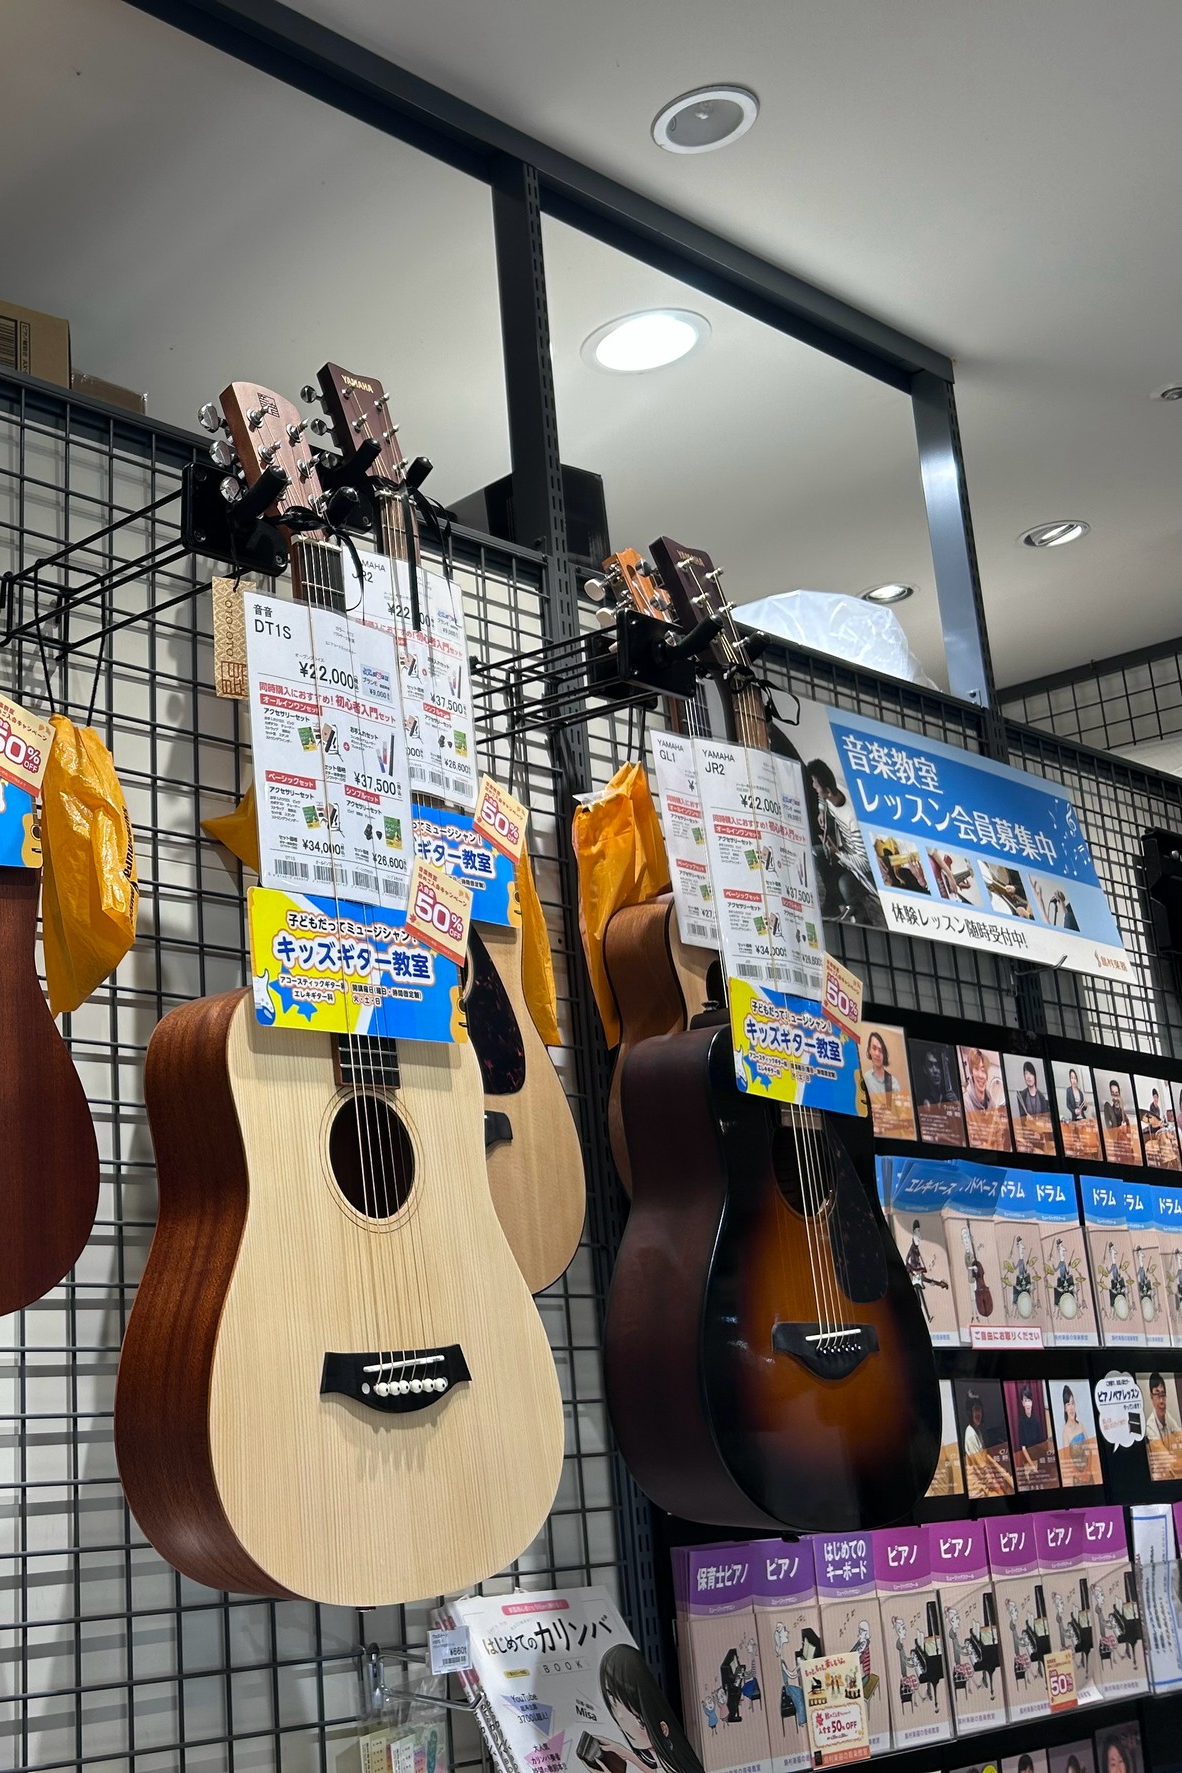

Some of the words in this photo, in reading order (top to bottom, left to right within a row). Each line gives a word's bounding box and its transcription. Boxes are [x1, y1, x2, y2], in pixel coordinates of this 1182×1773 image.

[341, 374, 374, 394] YAMAHA
[253, 604, 273, 618] 音音
[224, 599, 234, 657] OTO-OTO
[254, 619, 292, 640] DT1S
[298, 661, 354, 691] ¥22,000
[259, 681, 334, 706] 同時購入におすすめ!
[335, 695, 397, 724] 初心者入門セット
[263, 707, 311, 723] アクセサリーセット
[657, 738, 685, 753] YAMAHA
[23, 760, 38, 772] OFF
[659, 750, 677, 763] GL1
[702, 749, 736, 763] YAMAHA
[842, 734, 943, 796] 音楽教室
[705, 762, 726, 776] JR2
[267, 772, 314, 788] ベーシックセット
[354, 771, 397, 796] ¥37,500
[269, 785, 315, 800] アクセサリーセット
[481, 801, 519, 840] 50%
[856, 777, 1058, 867] レッスン会員募集中
[302, 839, 341, 855] ¥34,000
[508, 833, 518, 844] OFF
[372, 852, 404, 870] ¥26,600
[415, 890, 463, 933] 50%
[449, 928, 462, 940] OFF
[891, 902, 1029, 949] 体験レッスン随時受付中!
[277, 936, 431, 979] キッズギター教室
[746, 1016, 842, 1063] キッズギター教室
[905, 1178, 958, 1195] エレキベース
[1036, 1184, 1066, 1202] ドラム
[1092, 1188, 1117, 1207] ドラム
[1159, 1197, 1182, 1215] ドラム
[974, 1331, 1041, 1342] ご自由にお取りください
[1047, 1527, 1073, 1547] ピアノ
[1084, 1521, 1114, 1541] ピアノ
[823, 1539, 866, 1562] はじめての
[939, 1538, 973, 1559] ピアノ
[1000, 1531, 1026, 1552] ピアノ
[887, 1544, 918, 1567] ピアノ
[697, 1562, 749, 1592] 保育士ピアノ
[766, 1557, 800, 1581] ピアノ
[826, 1560, 867, 1583] キーボード
[482, 1614, 612, 1655] はじめてのカリンバ
[542, 1660, 584, 1674] BOOK
[511, 1693, 538, 1704] YouTube
[575, 1706, 598, 1722] Misa
[846, 1721, 857, 1730] OFF
